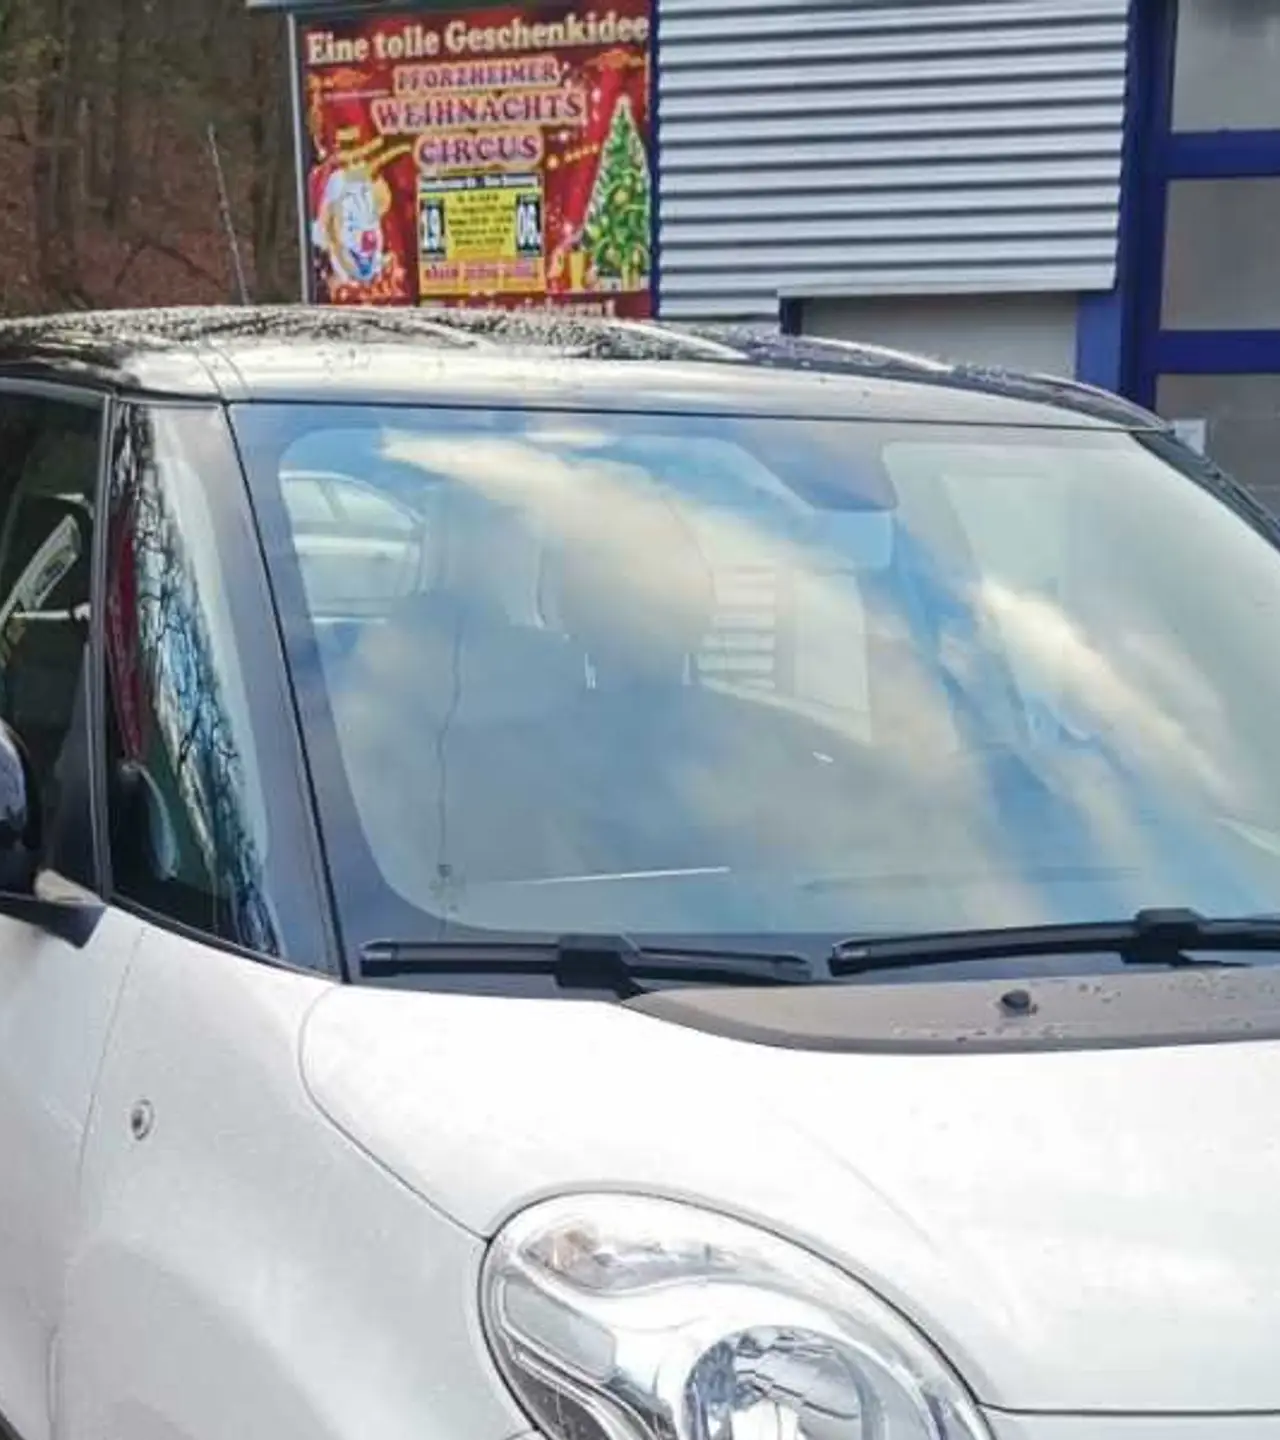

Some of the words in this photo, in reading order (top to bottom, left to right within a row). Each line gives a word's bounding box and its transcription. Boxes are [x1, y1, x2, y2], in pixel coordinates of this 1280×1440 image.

[307, 32, 369, 64] Eine
[374, 25, 440, 58] tolle
[445, 11, 649, 50] Geschenkidee
[398, 61, 557, 91] PFORZHEIMER
[376, 92, 582, 128] WEIHNACHTS
[420, 134, 539, 164] CIRCUS
